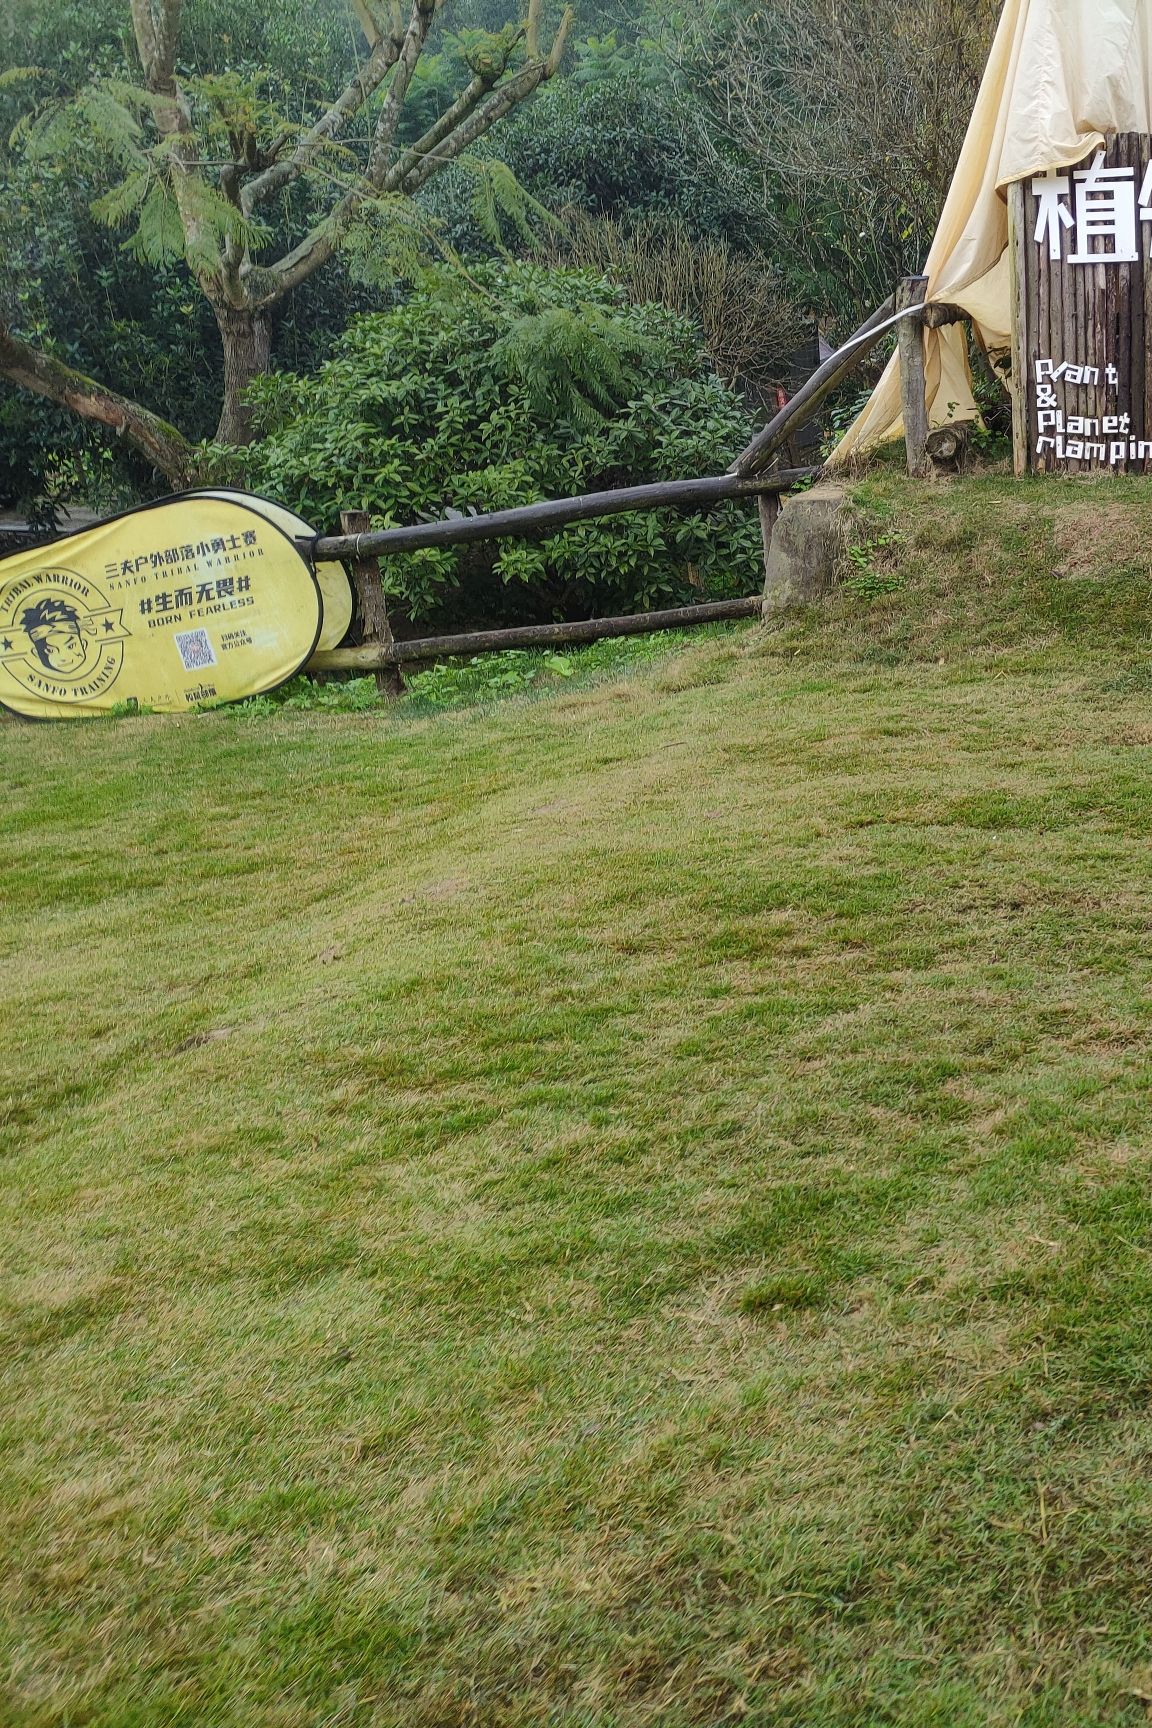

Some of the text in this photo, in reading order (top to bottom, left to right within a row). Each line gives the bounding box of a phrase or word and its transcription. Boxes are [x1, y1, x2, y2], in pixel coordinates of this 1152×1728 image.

[1036, 384, 1057, 408] &
[104, 529, 257, 580] 三夫户外部落小勇士赛
[109, 548, 264, 591] SANFO TRIBAL WARRIOR
[1, 573, 90, 613] TRIBAL WARRIOR
[139, 575, 252, 615] #生而无畏#
[148, 596, 255, 628] BORN FEARLESS
[27, 655, 116, 697] SANFO TRAINING
